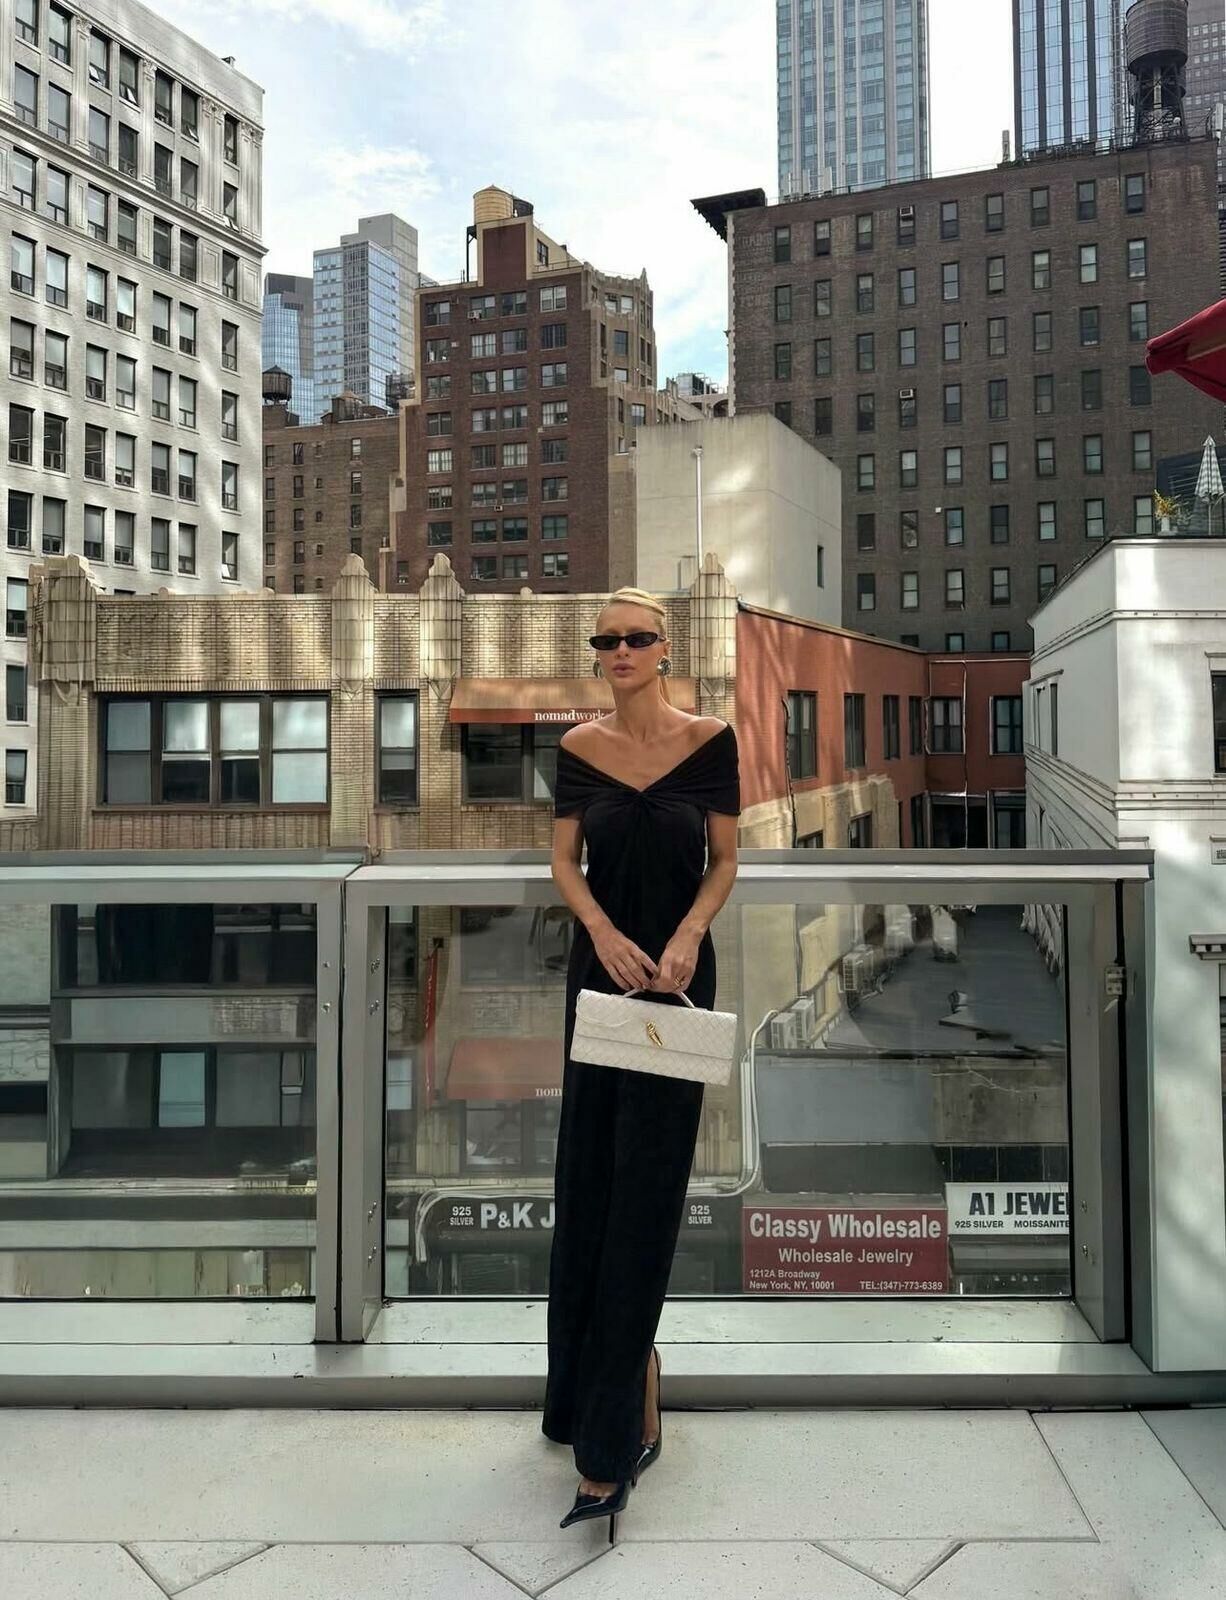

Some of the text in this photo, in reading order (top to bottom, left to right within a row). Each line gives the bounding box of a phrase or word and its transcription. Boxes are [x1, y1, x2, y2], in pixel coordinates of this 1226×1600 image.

[969, 1192, 995, 1216] A1
[452, 1206, 472, 1216] 925
[690, 1205, 710, 1215] 925
[480, 1202, 534, 1229] P&K
[688, 1216, 712, 1225] SILVER
[449, 1217, 474, 1226] SILVER
[954, 1220, 972, 1229] 925
[973, 1220, 1004, 1229] SILVER
[749, 1212, 941, 1244] Classy Wholesale
[778, 1248, 914, 1267] Wholesale Jewelry
[750, 1269, 821, 1280] 1212A Broadway
[749, 1281, 835, 1290] New York, NY, 10001
